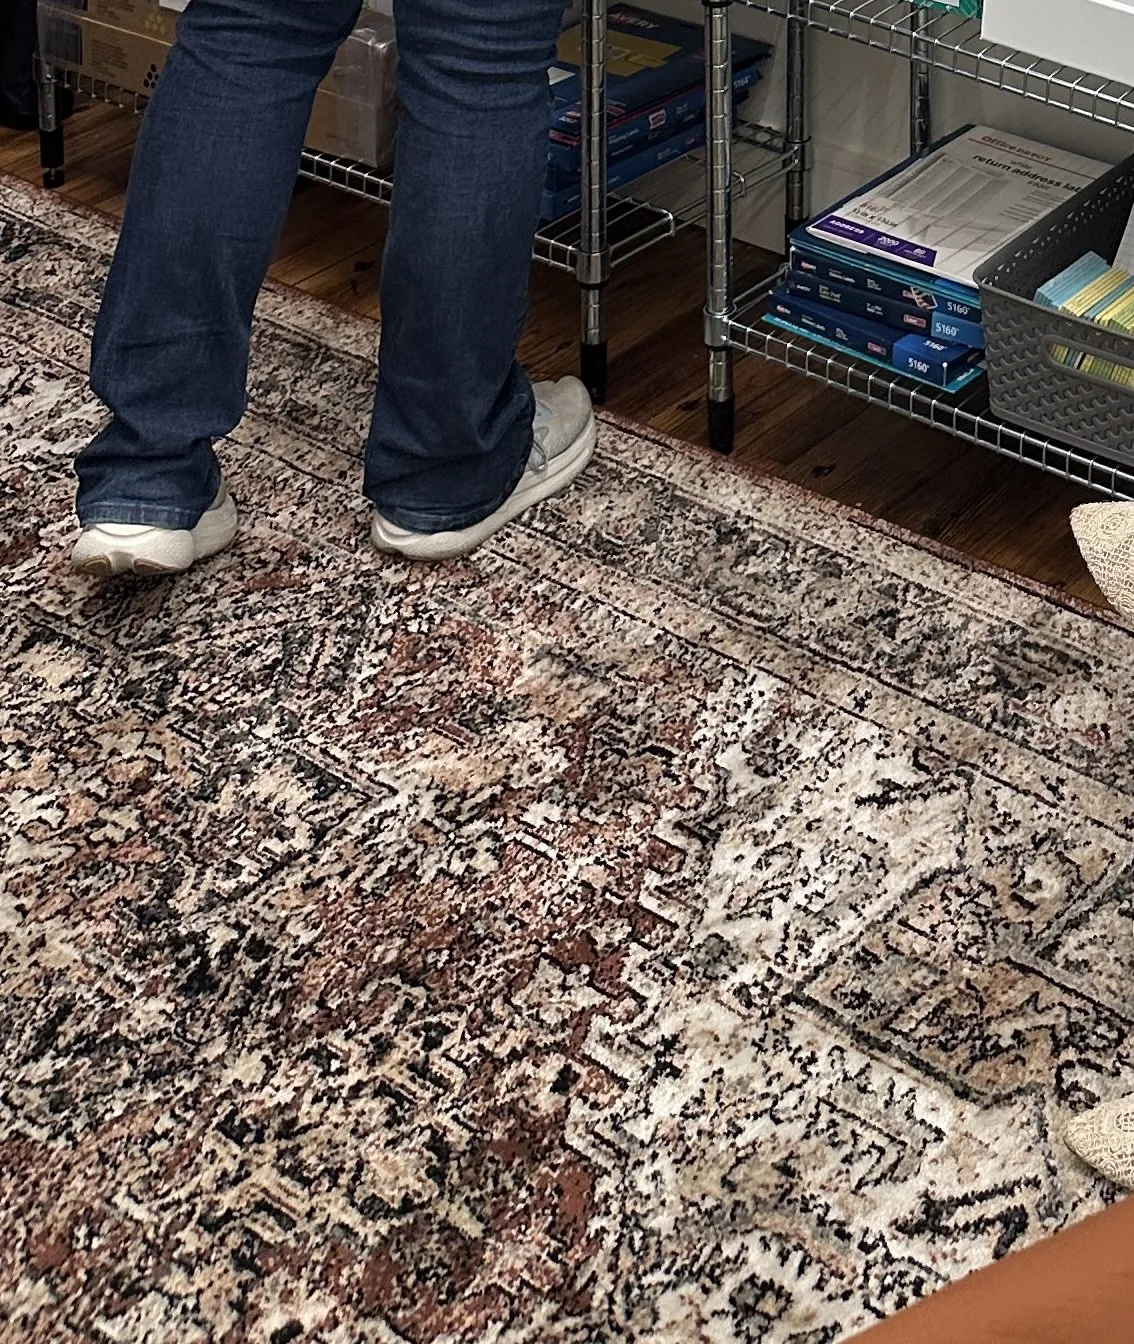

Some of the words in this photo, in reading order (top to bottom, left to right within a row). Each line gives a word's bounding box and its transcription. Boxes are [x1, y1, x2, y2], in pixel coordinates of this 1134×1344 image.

[982, 135, 1017, 151] Office
[1017, 146, 1052, 162] DEPOT
[972, 154, 1010, 171] return
[1011, 167, 1062, 186] address
